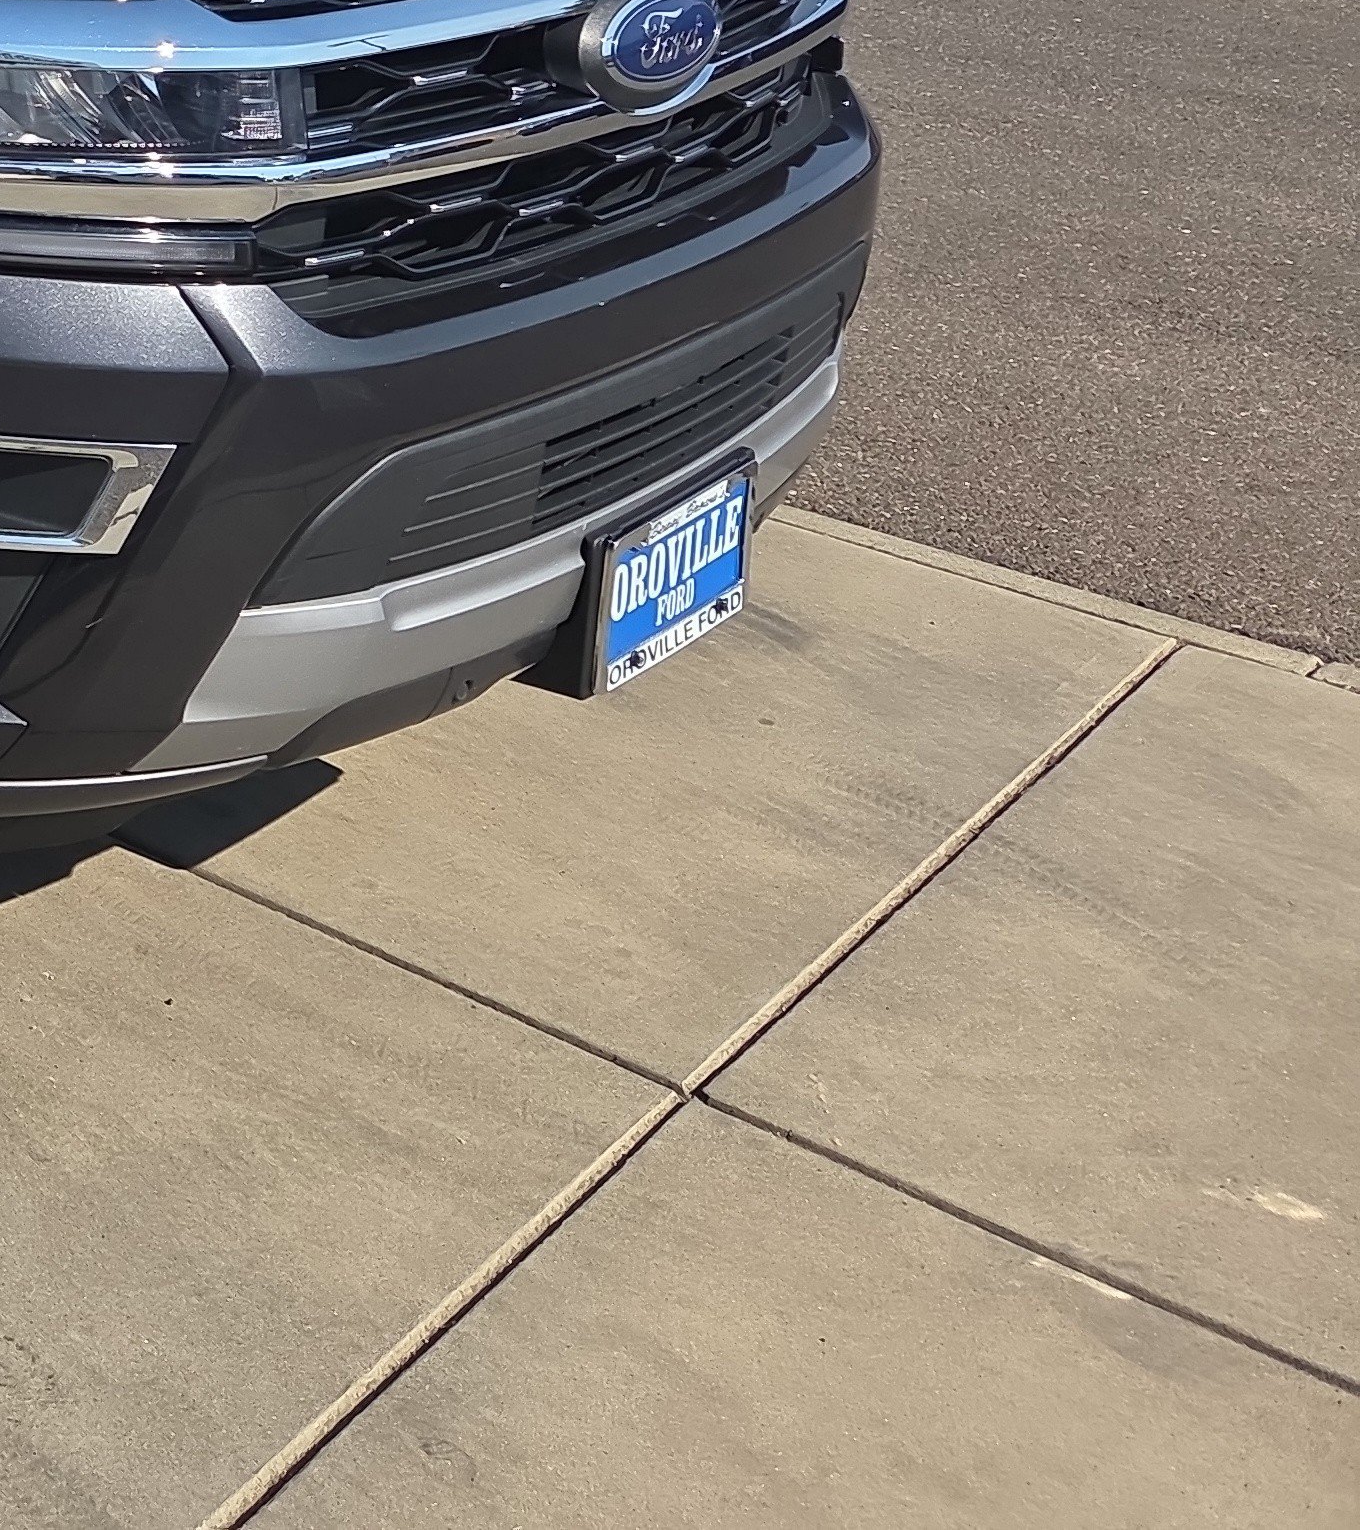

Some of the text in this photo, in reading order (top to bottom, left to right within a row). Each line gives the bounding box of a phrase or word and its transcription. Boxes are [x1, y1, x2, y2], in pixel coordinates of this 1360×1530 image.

[640, 7, 705, 70] Ford
[610, 495, 744, 622] OROVILLE
[655, 577, 696, 627] FORD
